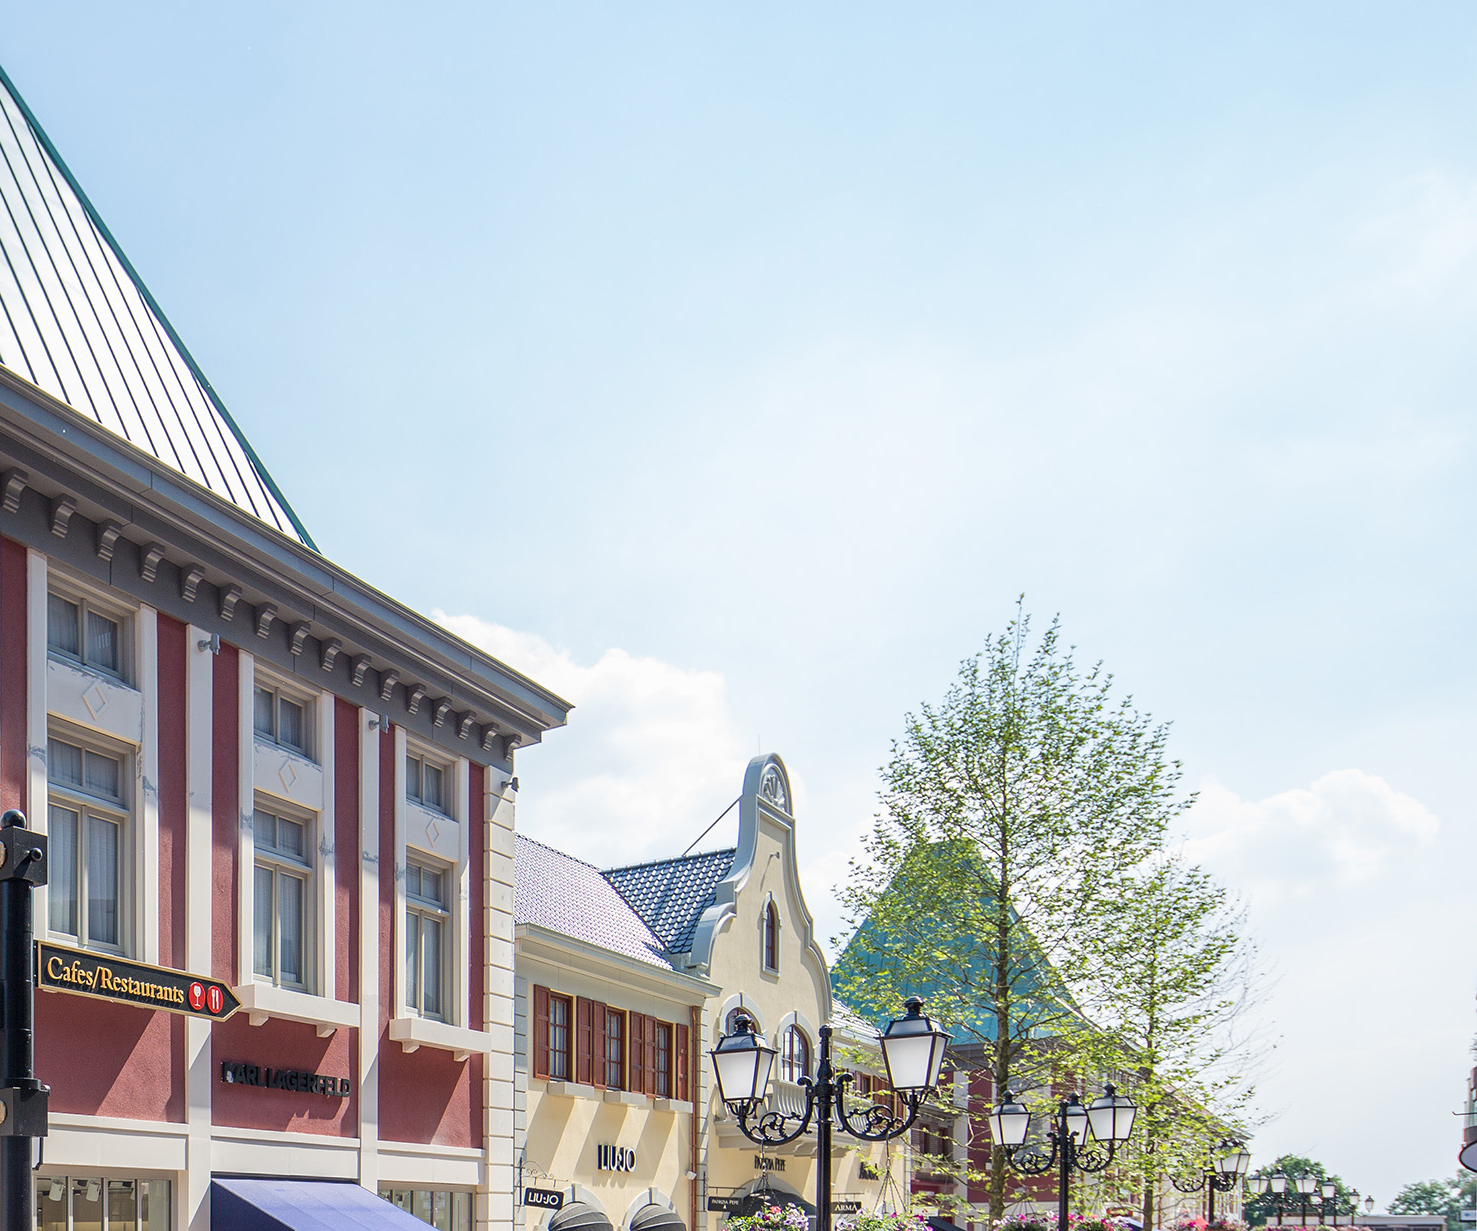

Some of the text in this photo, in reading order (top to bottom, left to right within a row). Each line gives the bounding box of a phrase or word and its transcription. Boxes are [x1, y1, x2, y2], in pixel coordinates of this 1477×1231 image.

[47, 957, 184, 1004] Cafes/Restaurants
[222, 1061, 352, 1098] KARL LAGERFELD
[834, 1203, 858, 1211] ARMA
